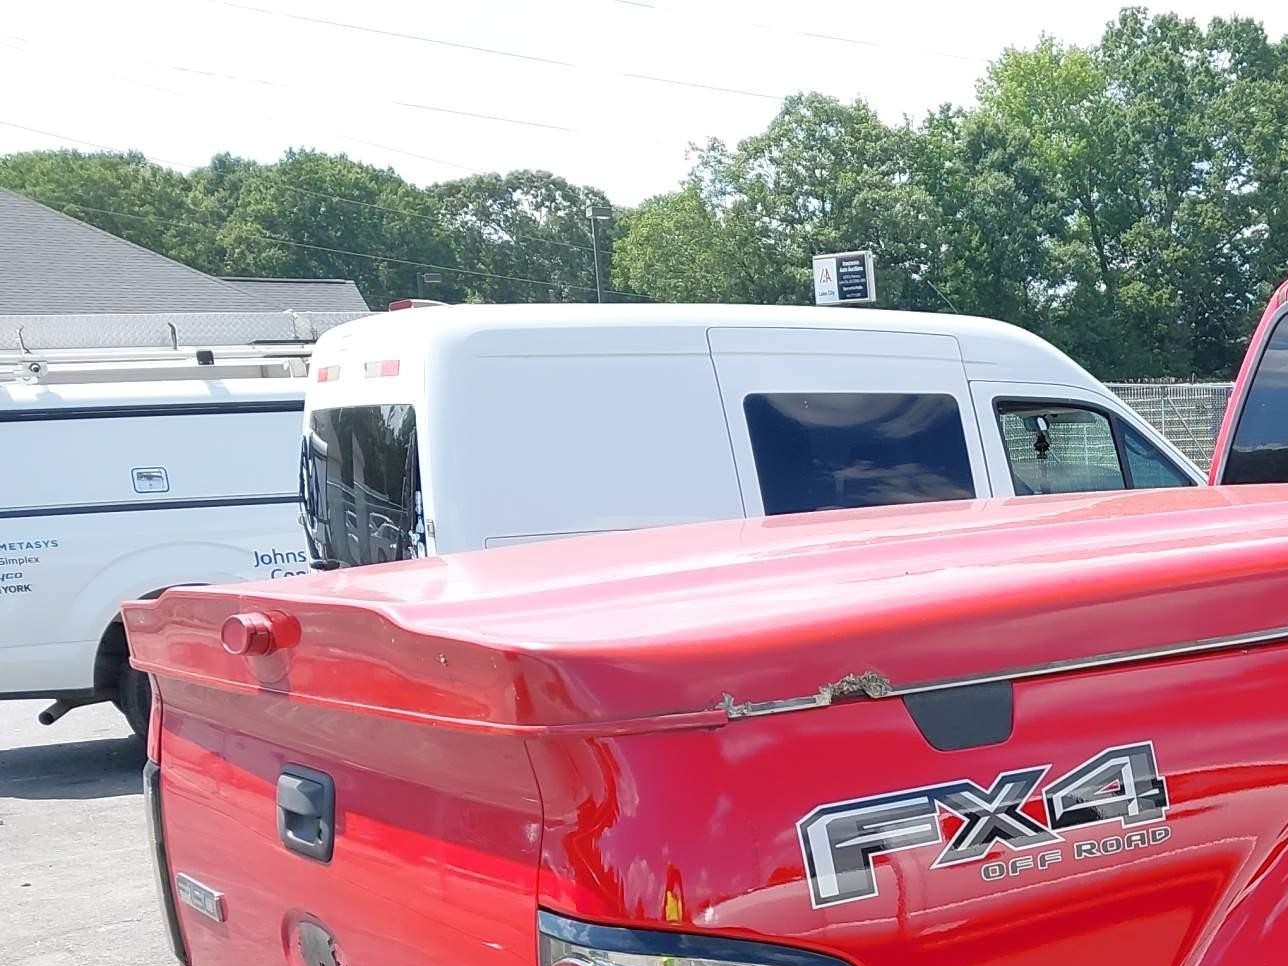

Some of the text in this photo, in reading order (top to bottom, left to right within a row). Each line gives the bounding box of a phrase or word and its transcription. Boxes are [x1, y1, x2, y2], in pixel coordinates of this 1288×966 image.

[0, 540, 59, 551] METASYS
[0, 556, 40, 567] Simplex
[254, 548, 307, 568] Johns
[1, 584, 32, 594] YORK
[795, 740, 1171, 910] FX4
[981, 827, 1171, 881] OFF ROAD
